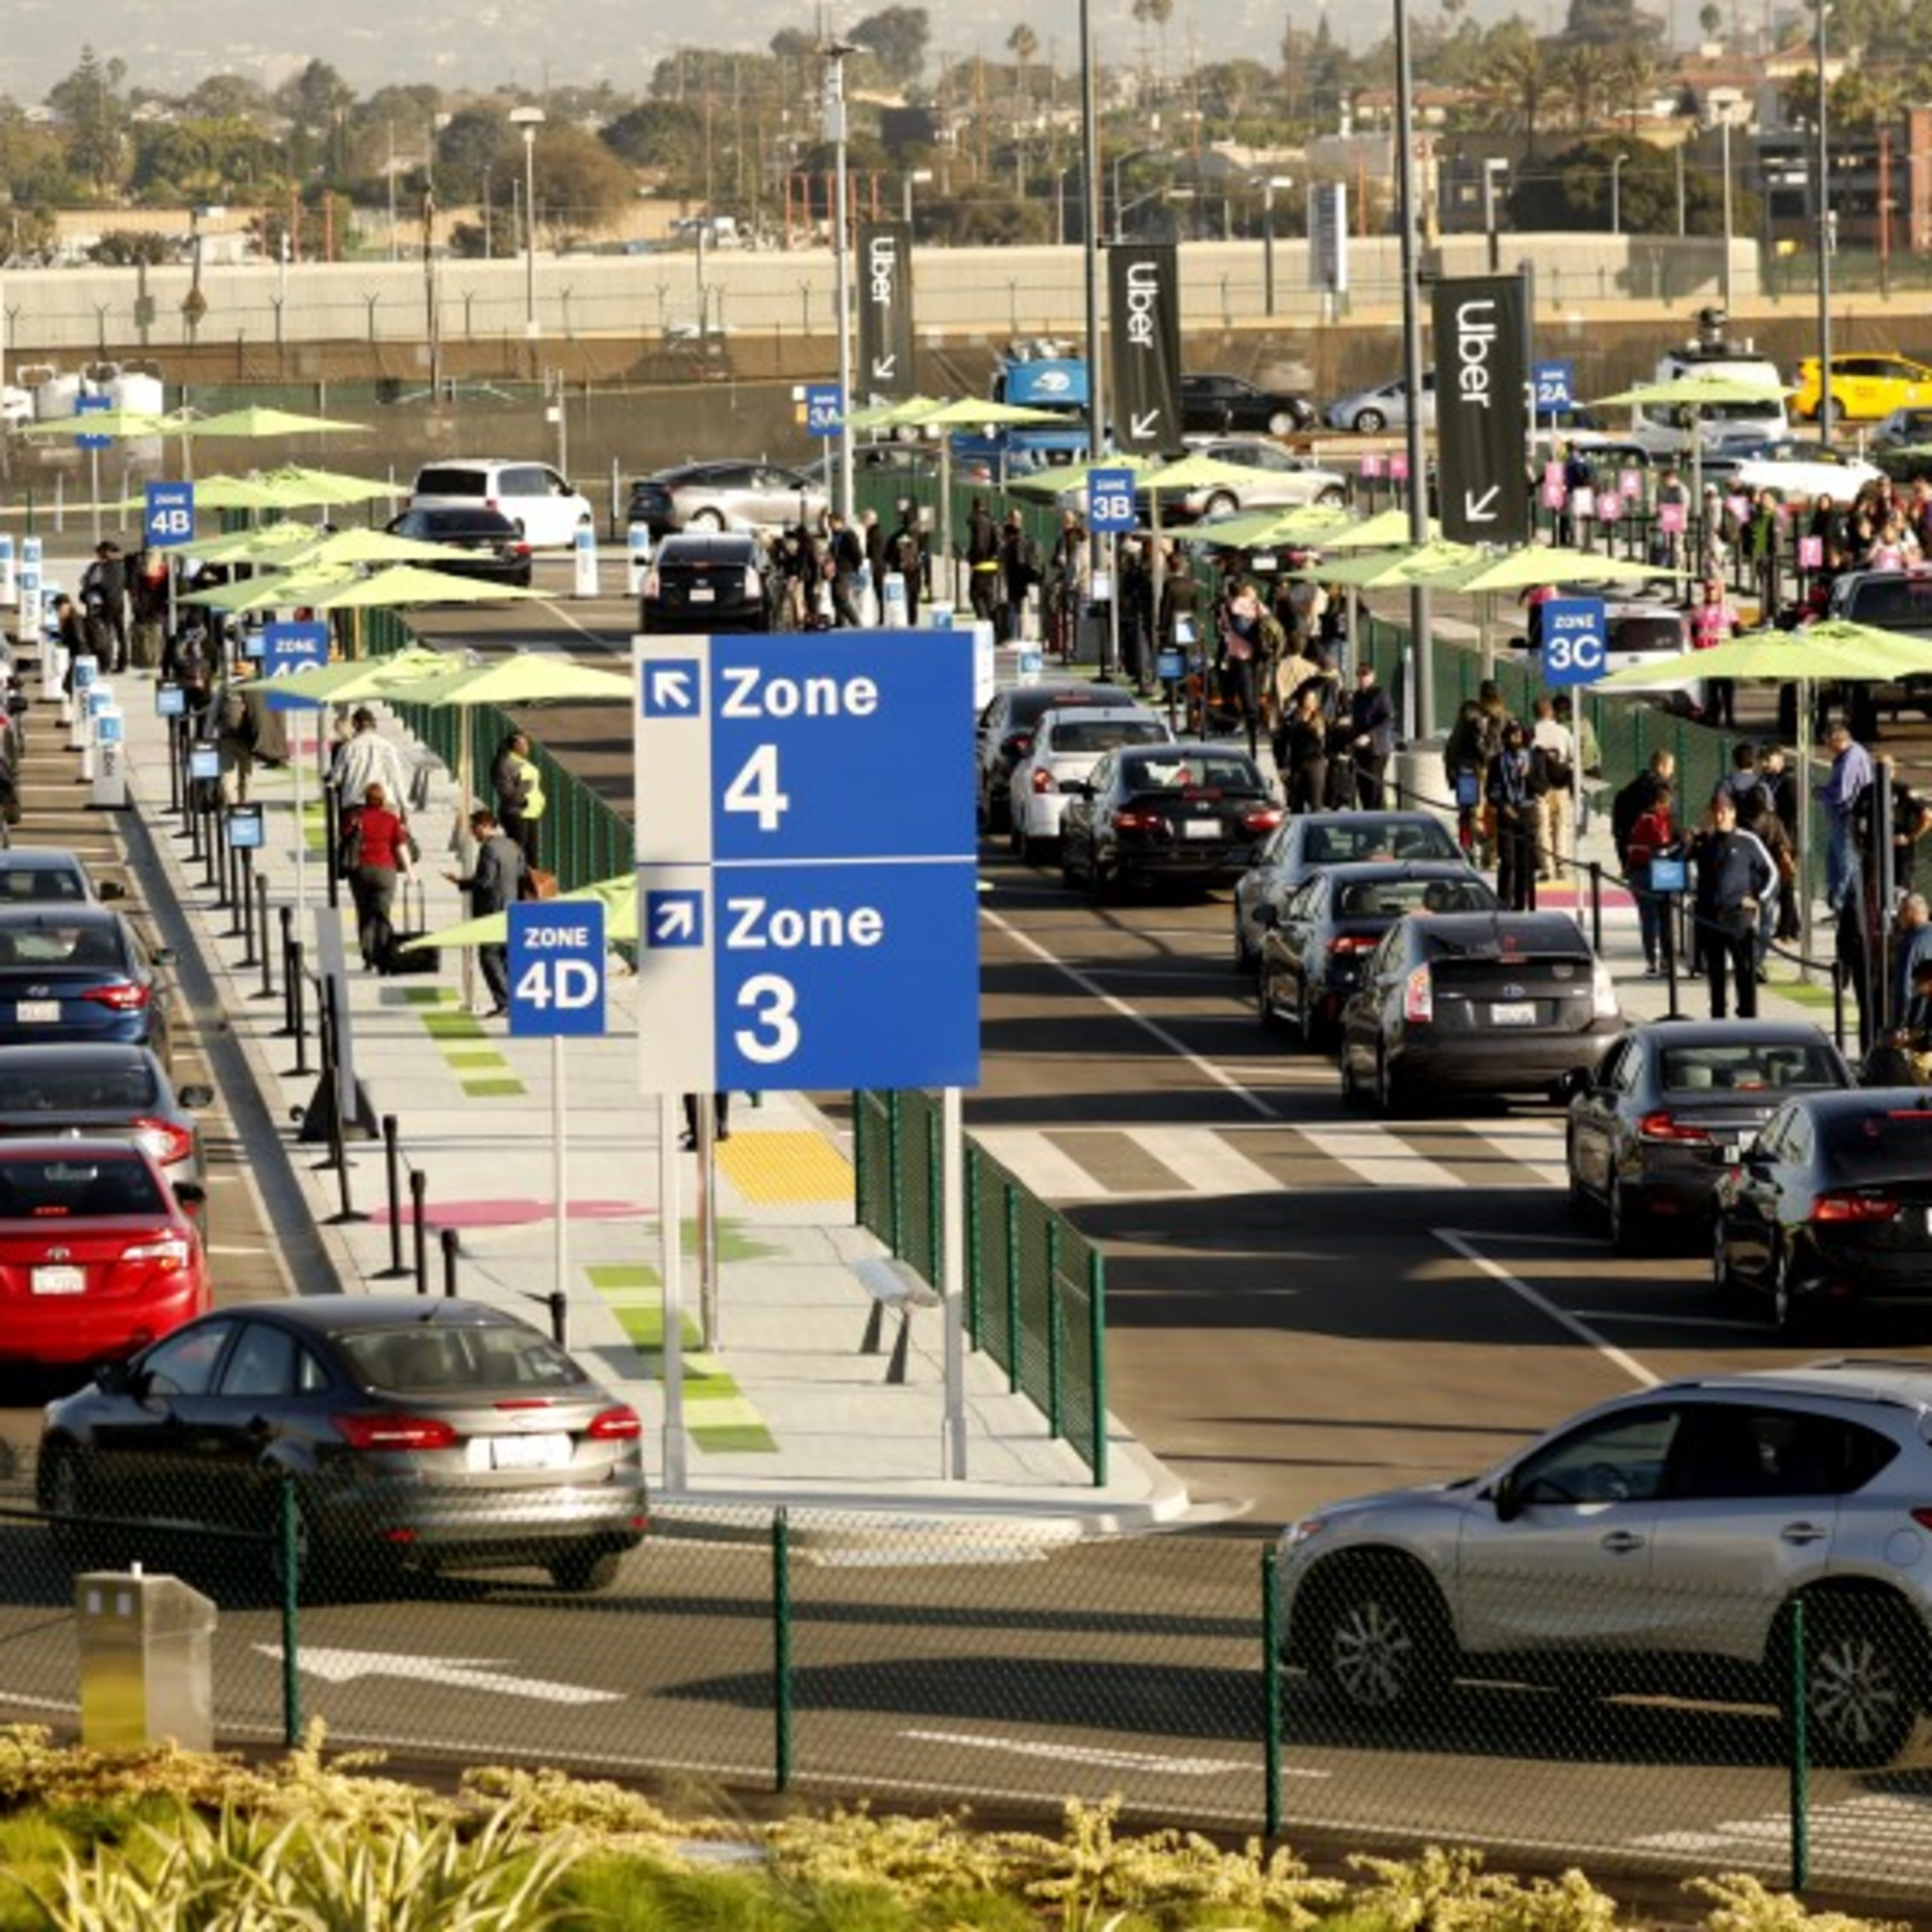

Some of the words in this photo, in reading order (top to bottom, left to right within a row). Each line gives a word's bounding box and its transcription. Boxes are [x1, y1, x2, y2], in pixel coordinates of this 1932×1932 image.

[870, 237, 895, 307] Uber
[1127, 261, 1159, 348] Uber
[1457, 300, 1497, 408] Uber
[1539, 383, 1569, 401] 2A
[151, 510, 190, 535] 4B
[1093, 495, 1130, 521] 3B
[275, 638, 318, 653] ZONE
[1553, 613, 1595, 629] ZONE
[1548, 634, 1602, 670] 3C
[721, 667, 878, 717] Zone
[723, 744, 789, 831] 4
[524, 927, 590, 948] ZONE
[726, 898, 884, 949] Zone
[516, 959, 598, 1009] 4D
[734, 973, 800, 1065] 3
